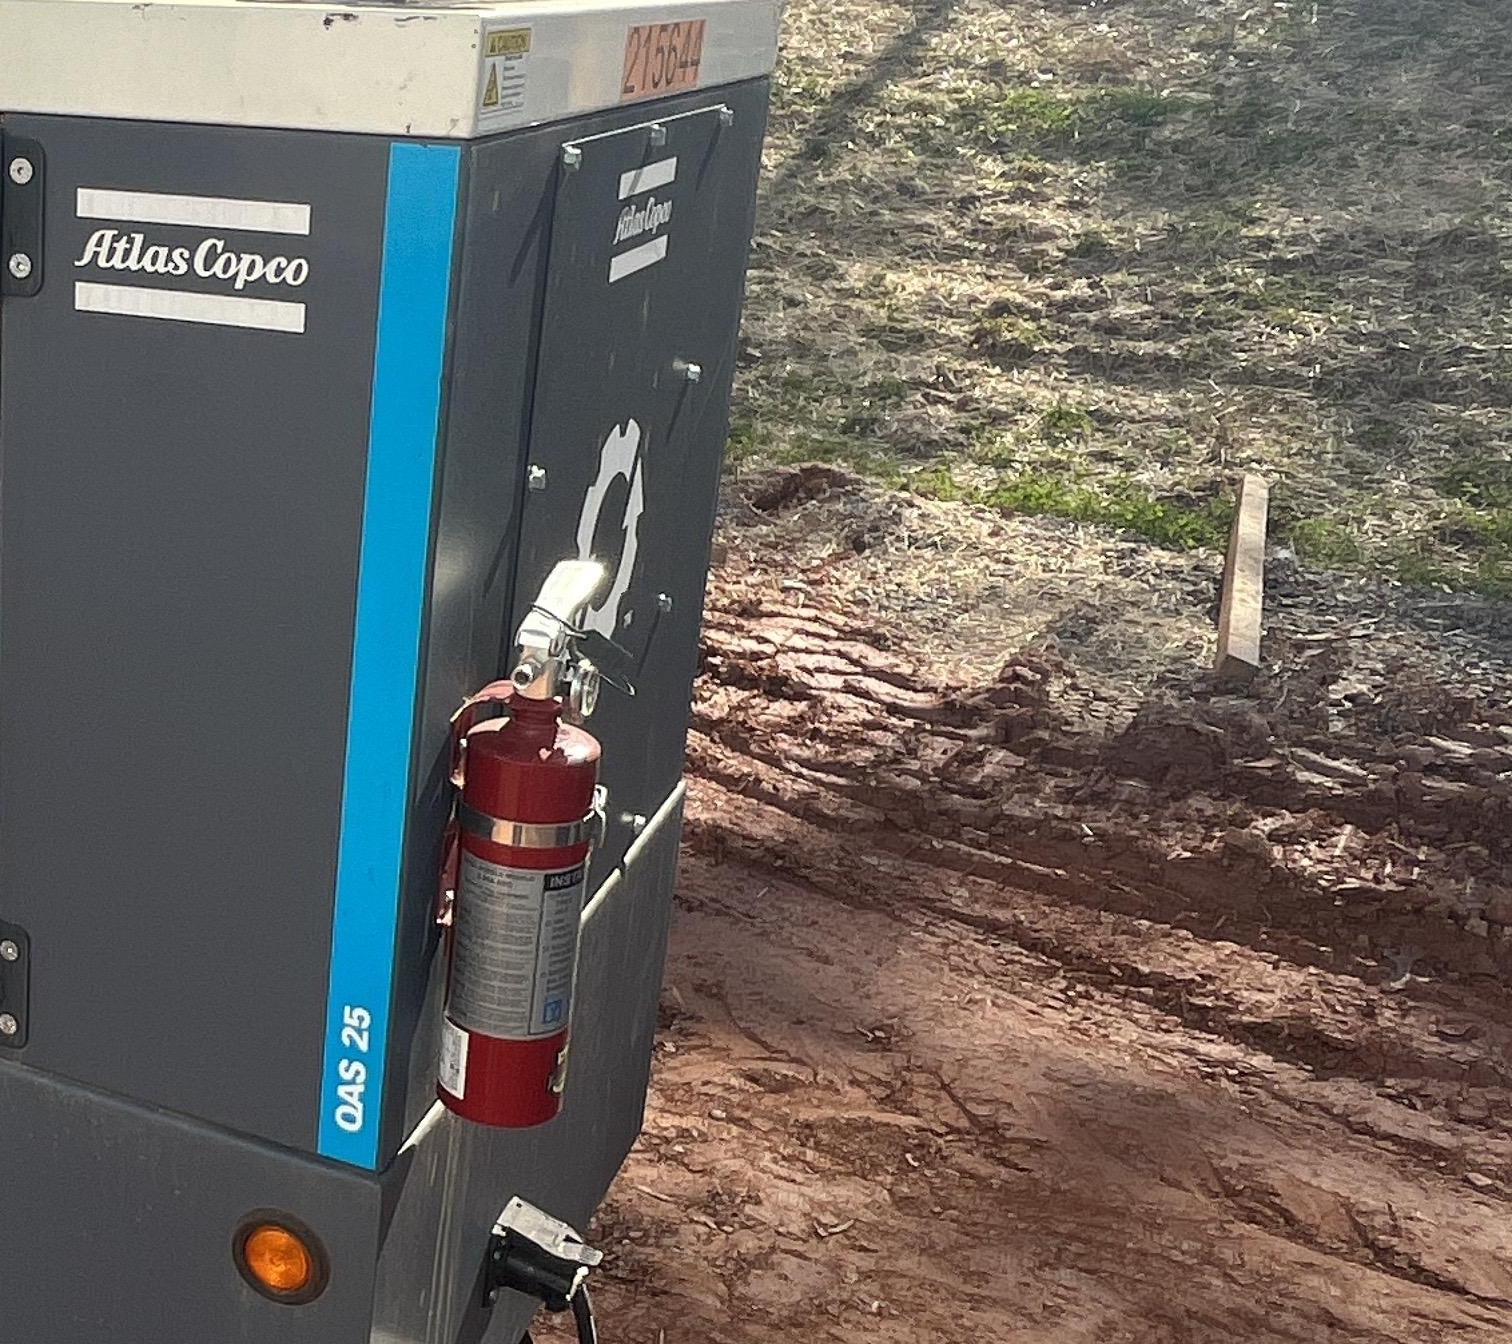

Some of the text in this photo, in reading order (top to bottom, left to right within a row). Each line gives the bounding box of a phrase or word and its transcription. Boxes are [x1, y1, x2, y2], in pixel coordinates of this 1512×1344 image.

[623, 20, 705, 94] 215644
[74, 229, 310, 290] Atlas Copco
[334, 1004, 372, 1133] QAS 25
